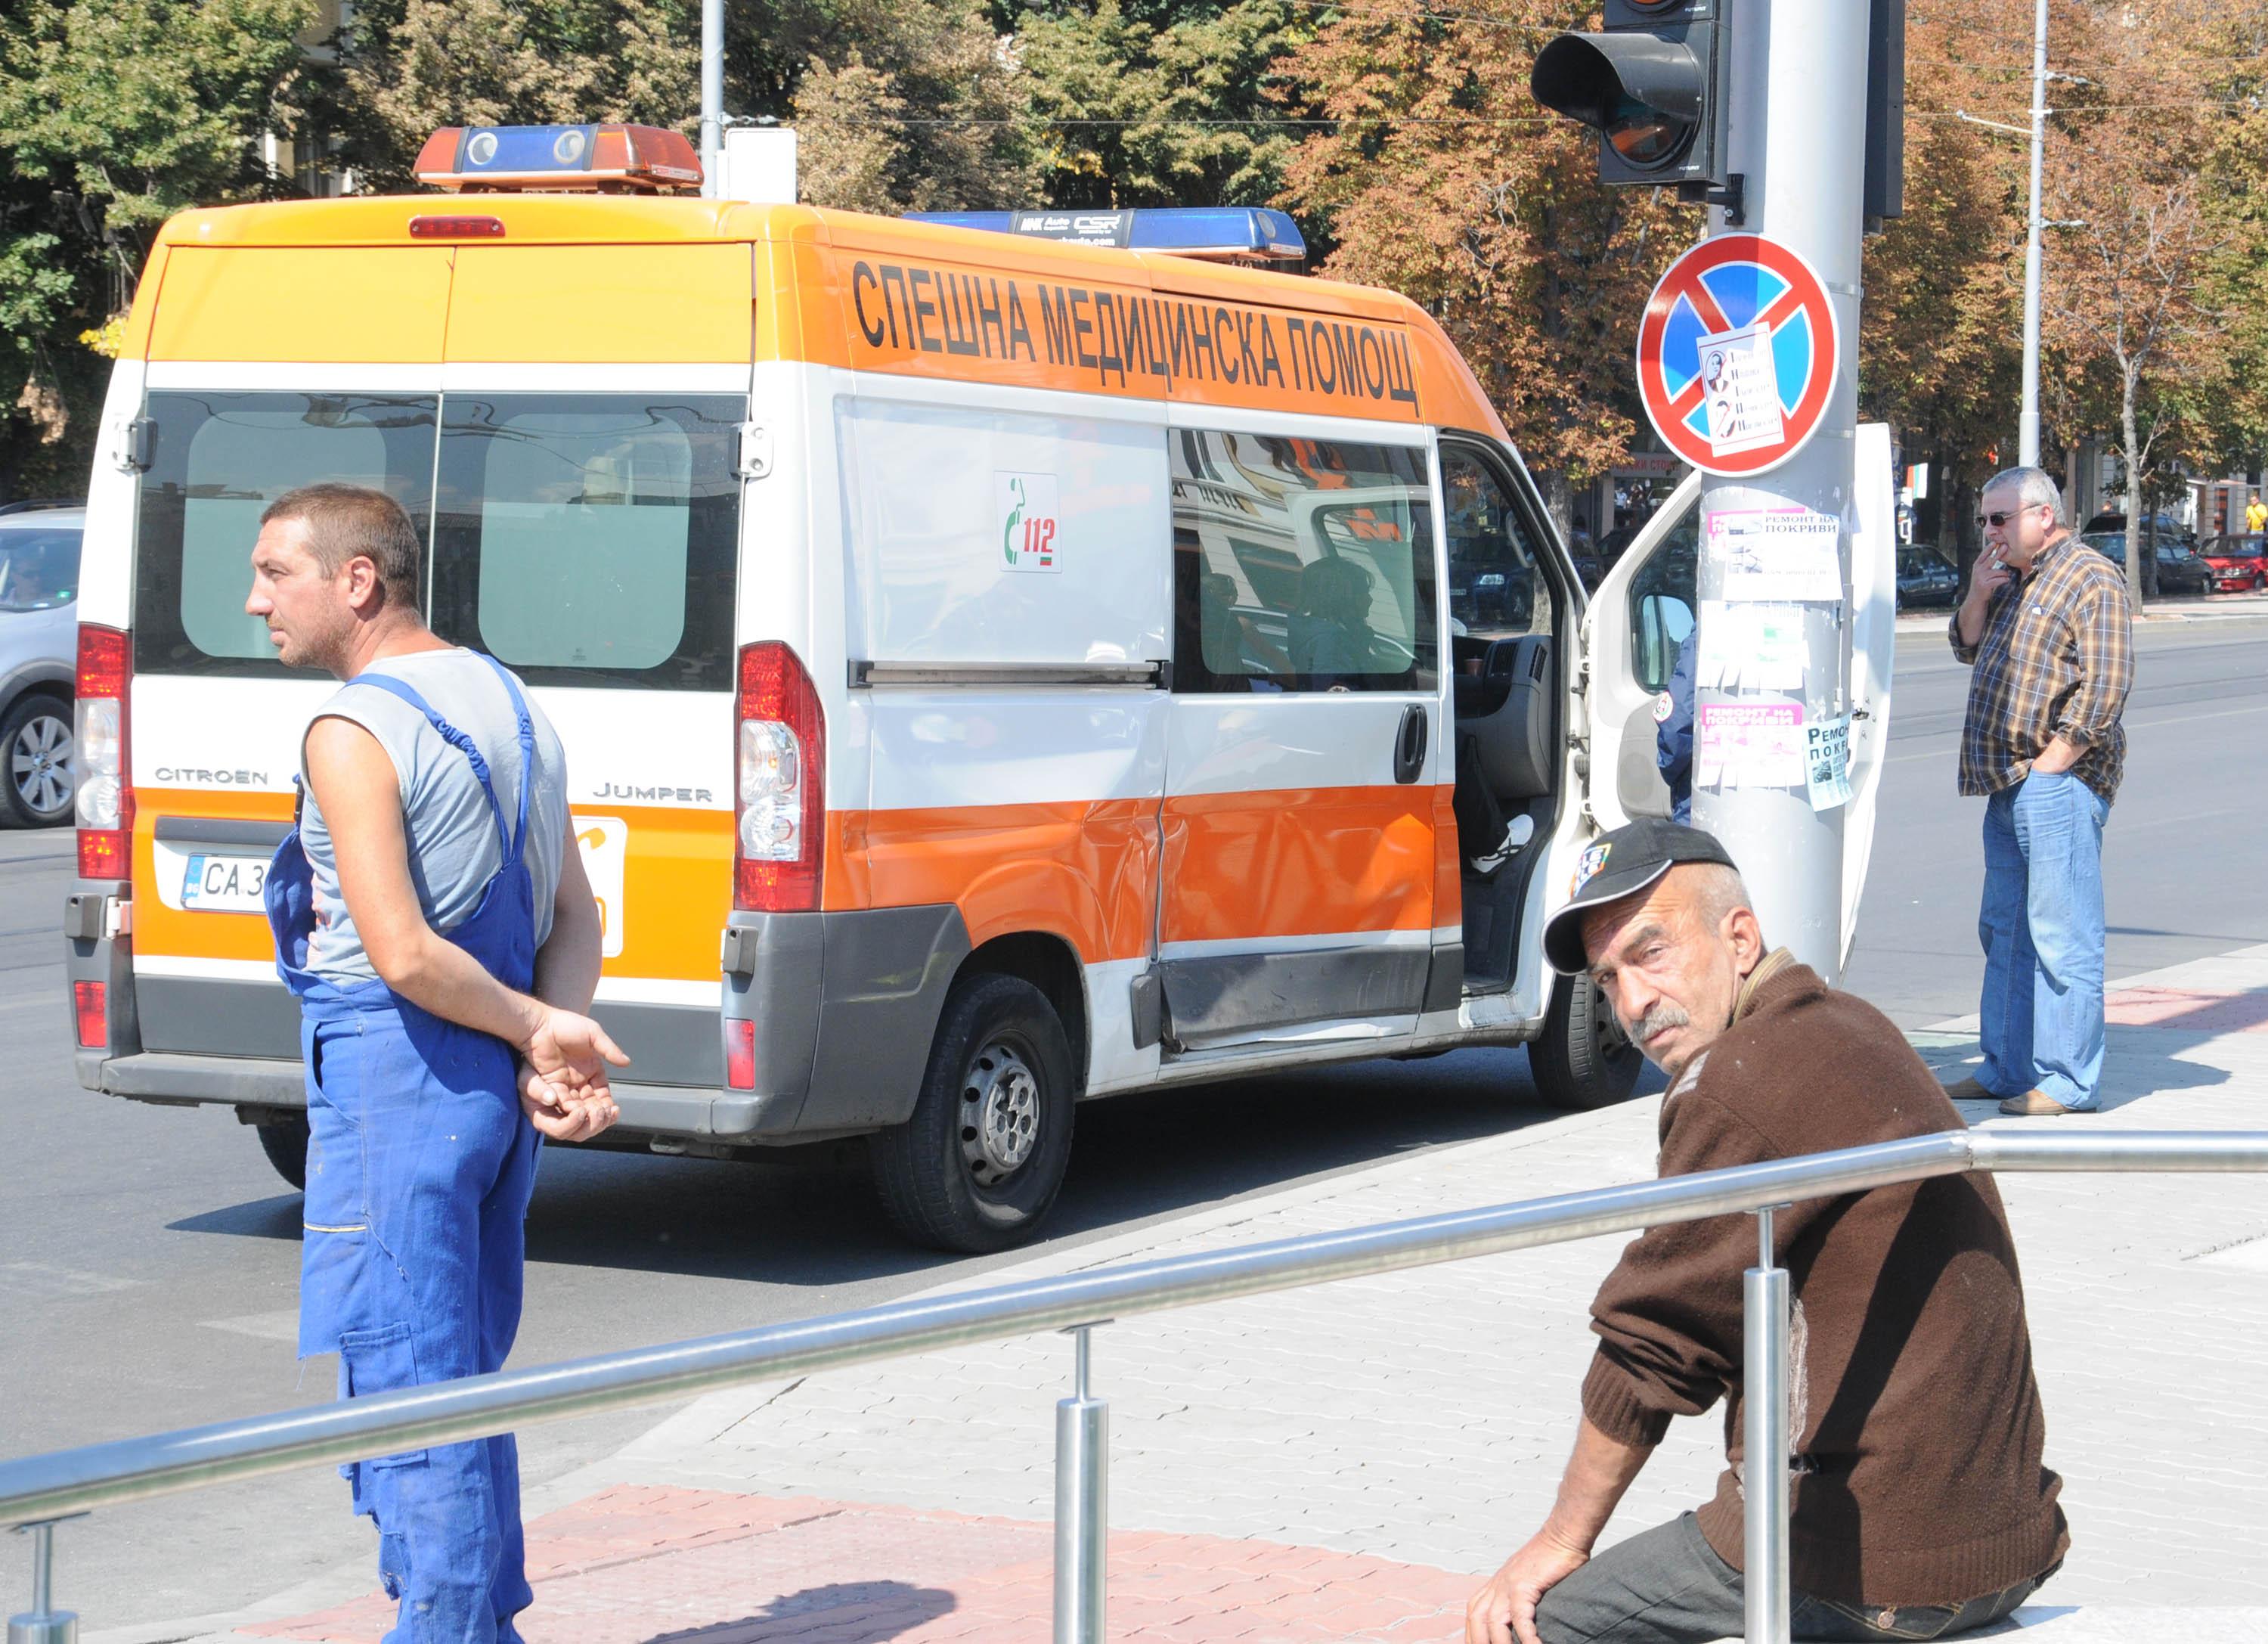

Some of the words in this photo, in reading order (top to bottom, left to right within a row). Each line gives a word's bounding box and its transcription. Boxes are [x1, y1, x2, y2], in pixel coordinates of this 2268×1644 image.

[1044, 216, 1070, 225] Auto
[1074, 216, 1120, 230] CSR
[853, 261, 1036, 362] СПЕШНА
[1037, 284, 1285, 393] МЕДИЦИНСКА
[1287, 317, 1420, 418] ПОМОЩ
[1765, 524, 1837, 533] ПОКРИВИ
[1024, 517, 1055, 553] 112
[1706, 707, 1770, 717] РЕМОНТ
[1773, 709, 1794, 717] НА
[1706, 716, 1795, 725] ПОКРИВИ
[593, 782, 713, 802] JUMPER
[186, 882, 199, 893] BG
